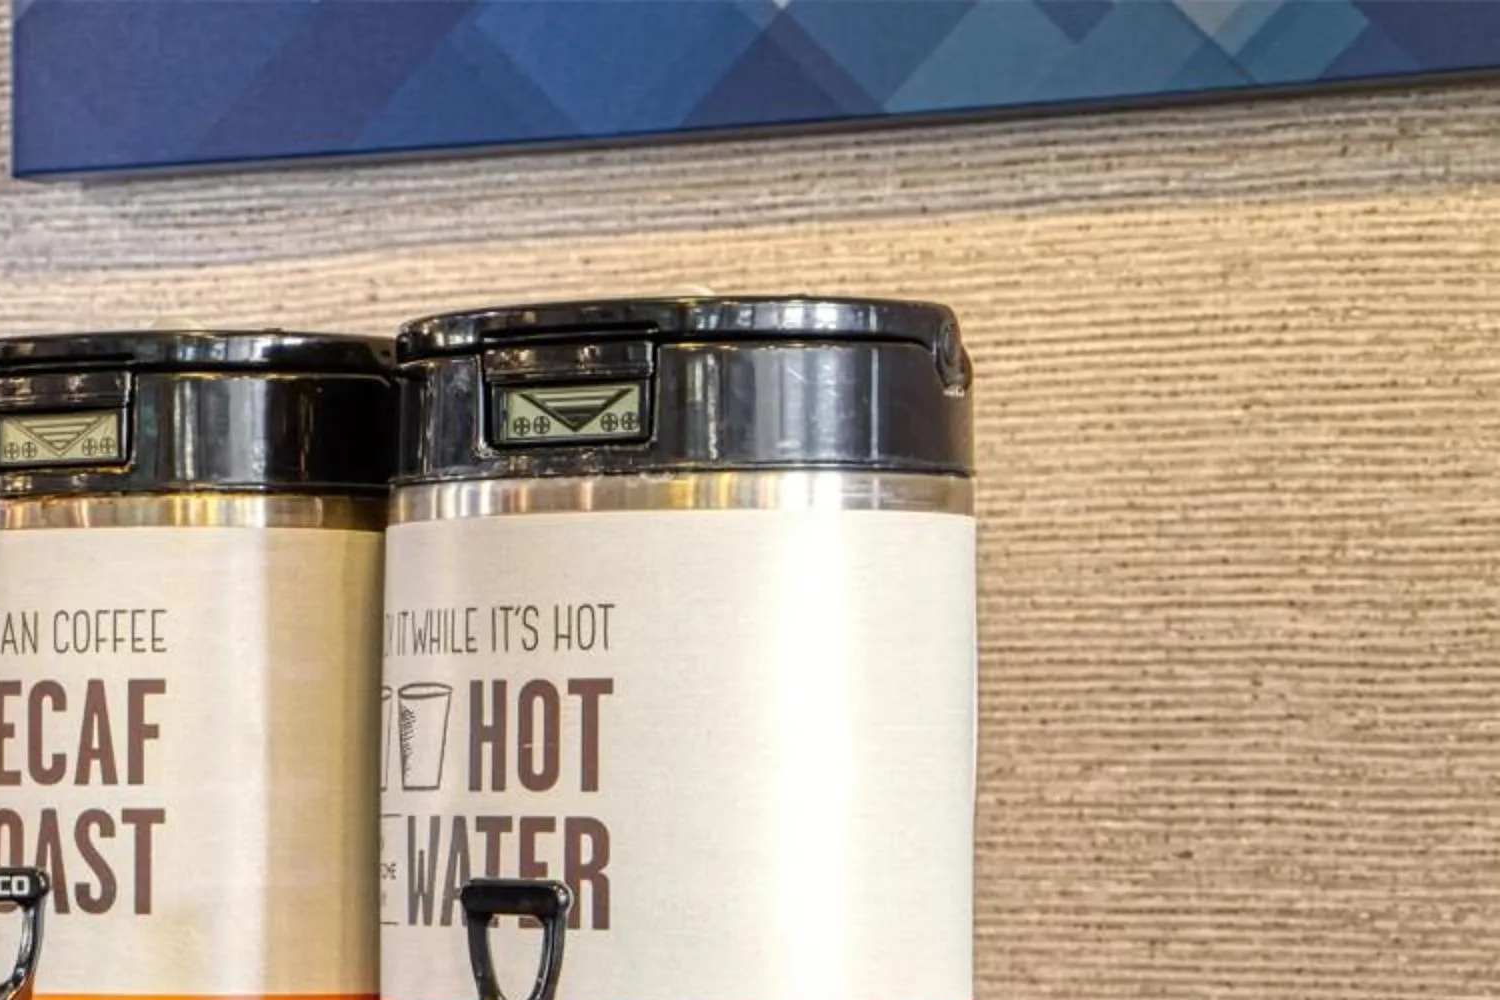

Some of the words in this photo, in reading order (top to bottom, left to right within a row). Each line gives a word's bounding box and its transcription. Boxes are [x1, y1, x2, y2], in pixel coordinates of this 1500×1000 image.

[52, 608, 168, 655] COFFEE
[411, 606, 479, 656] WHILE
[490, 604, 540, 653] IT'S
[552, 602, 616, 653] HOT
[467, 678, 614, 793] HOT
[407, 814, 611, 930] WATER
